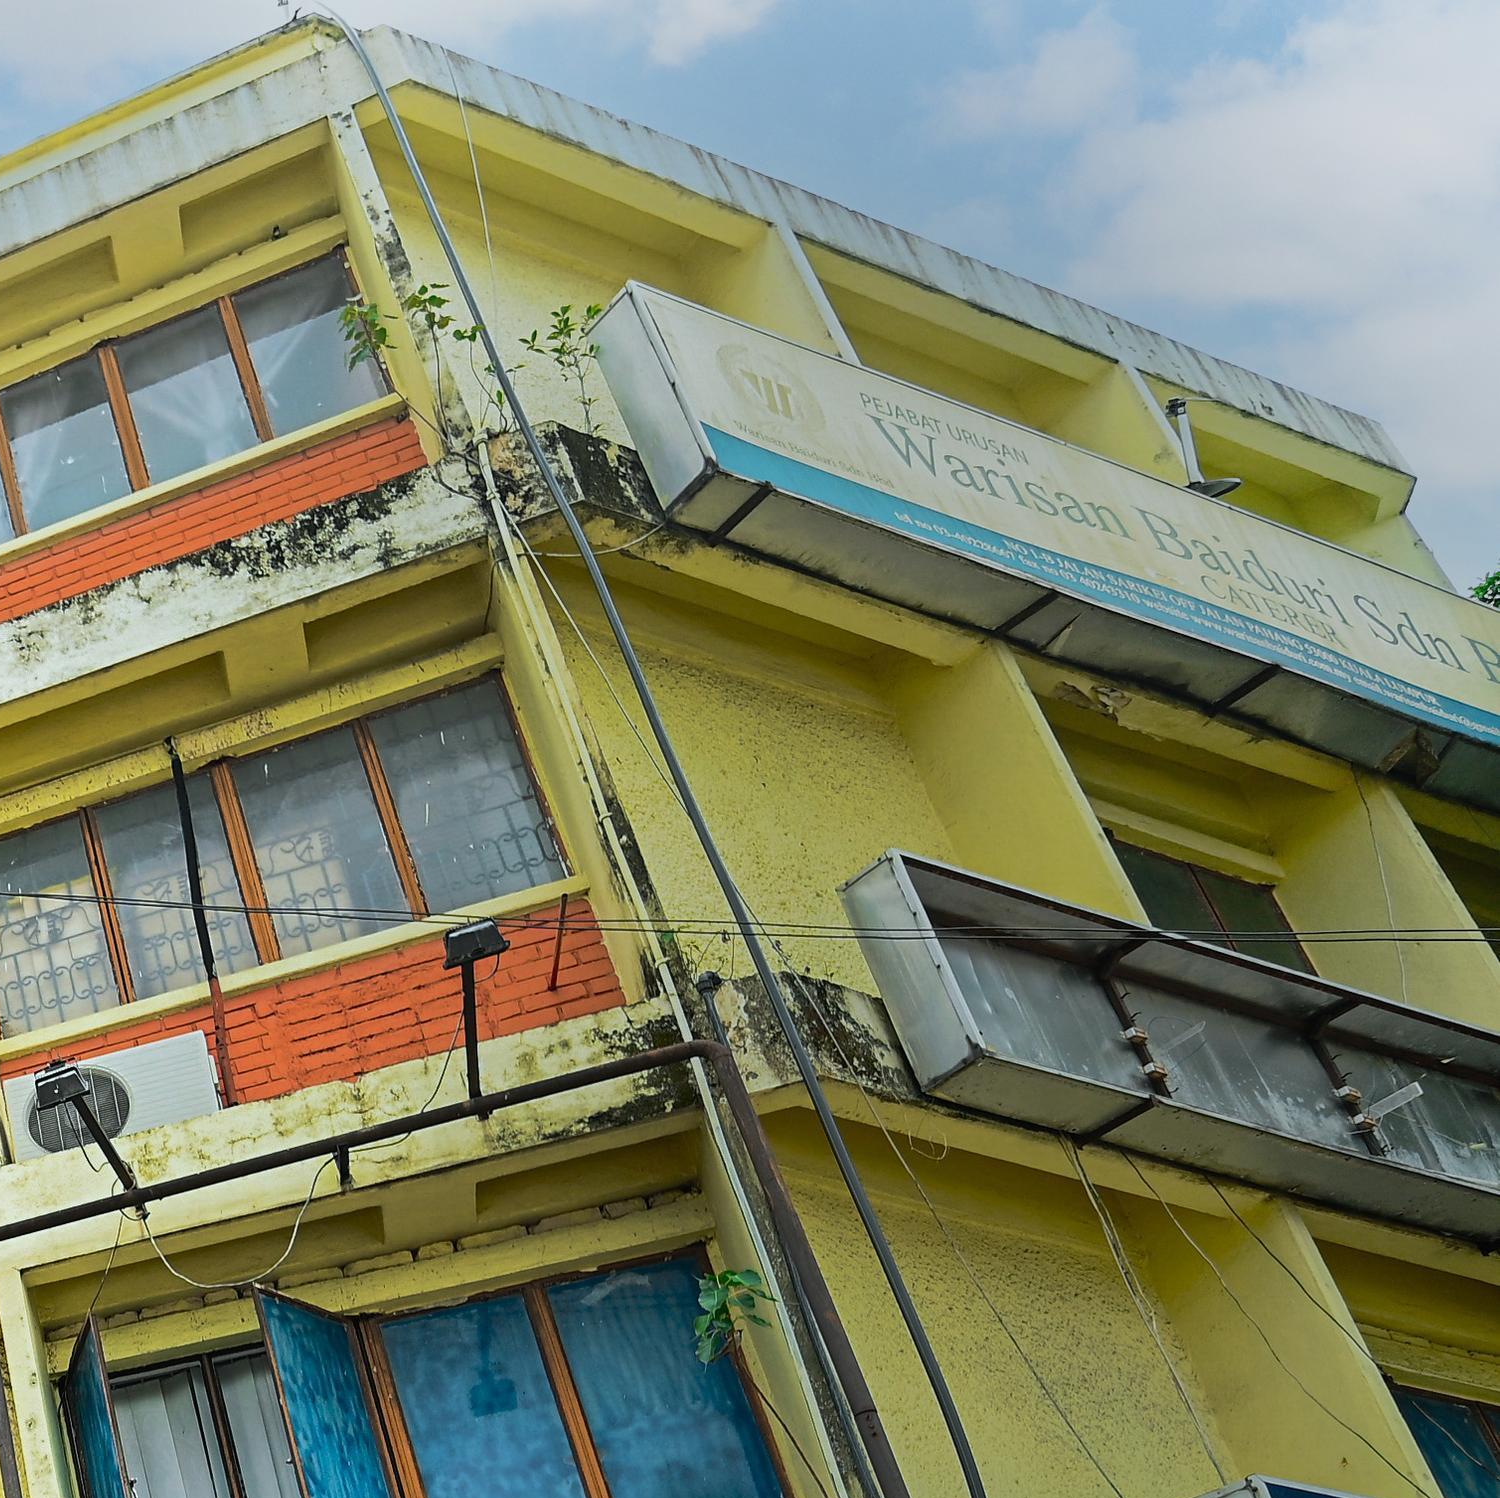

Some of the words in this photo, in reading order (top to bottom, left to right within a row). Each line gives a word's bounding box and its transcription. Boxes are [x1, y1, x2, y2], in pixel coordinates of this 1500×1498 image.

[859, 391, 941, 433] PEJABAT
[948, 422, 1028, 464] URUSAN
[865, 412, 1136, 542] Warisan
[1130, 503, 1354, 629] Baiduri
[1353, 593, 1471, 674] Sdn
[1200, 574, 1349, 649] CATERER
